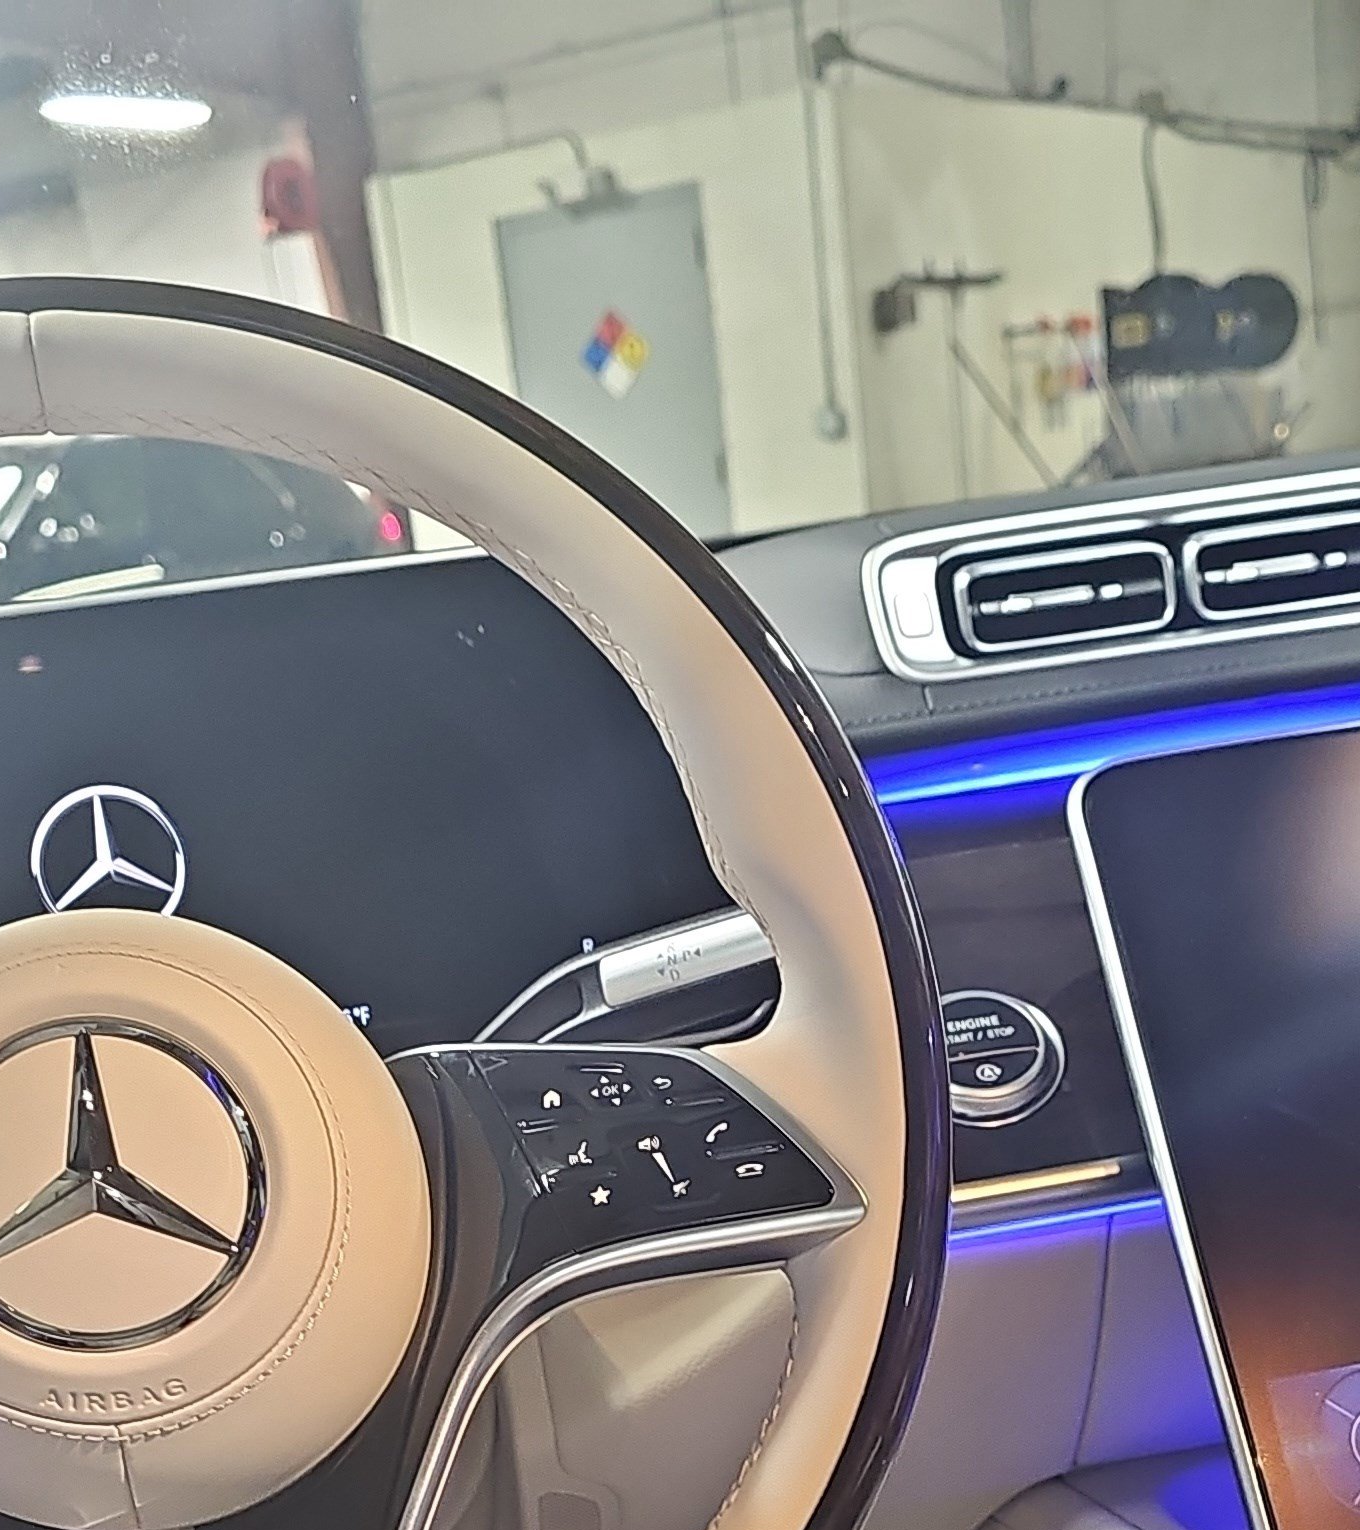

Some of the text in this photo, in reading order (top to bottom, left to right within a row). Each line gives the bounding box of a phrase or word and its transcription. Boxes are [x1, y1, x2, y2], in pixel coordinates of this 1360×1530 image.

[946, 1014, 1000, 1033] ENGINE
[946, 1031, 974, 1045] TART
[601, 1083, 620, 1097] OK
[40, 1377, 188, 1414] AIRBAG
